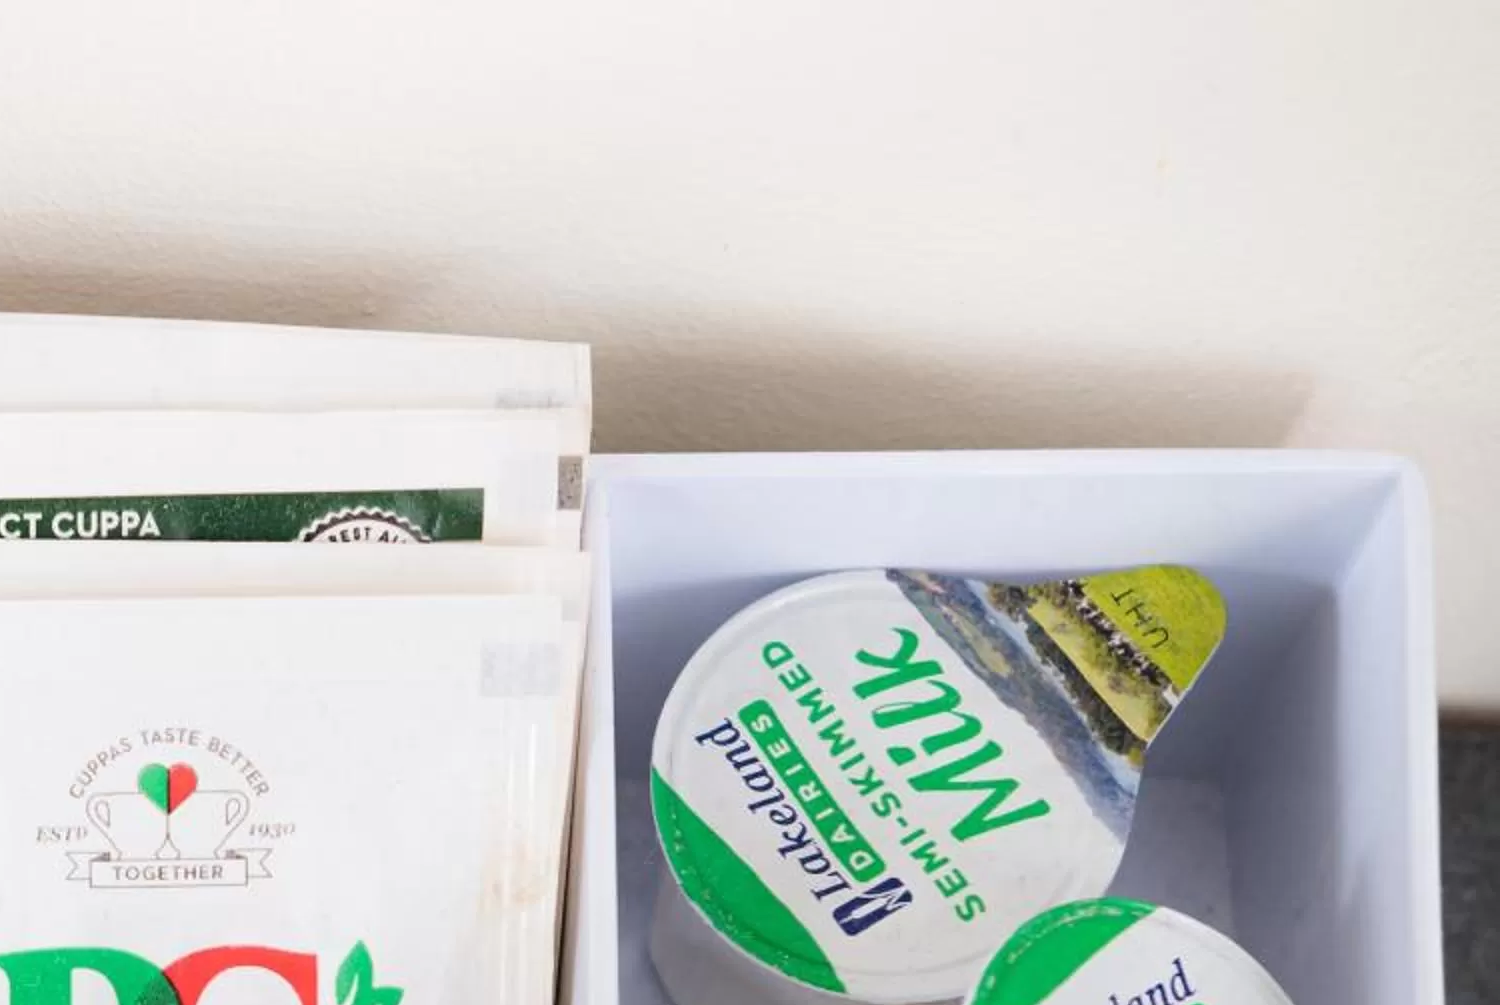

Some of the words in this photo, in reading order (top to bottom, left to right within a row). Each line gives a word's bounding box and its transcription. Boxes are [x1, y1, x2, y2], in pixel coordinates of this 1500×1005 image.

[51, 509, 162, 539] CUPPA
[1107, 586, 1171, 650] UHT
[68, 736, 134, 800] CUPPAS
[140, 727, 203, 748] TASTE
[208, 736, 271, 798] BETTER
[747, 712, 878, 874] DAIRIES
[761, 640, 987, 924] SEMI-SKIMMED
[852, 626, 1052, 844] Milk
[694, 716, 853, 906] Lakeland
[112, 864, 225, 882] TOGETHER
